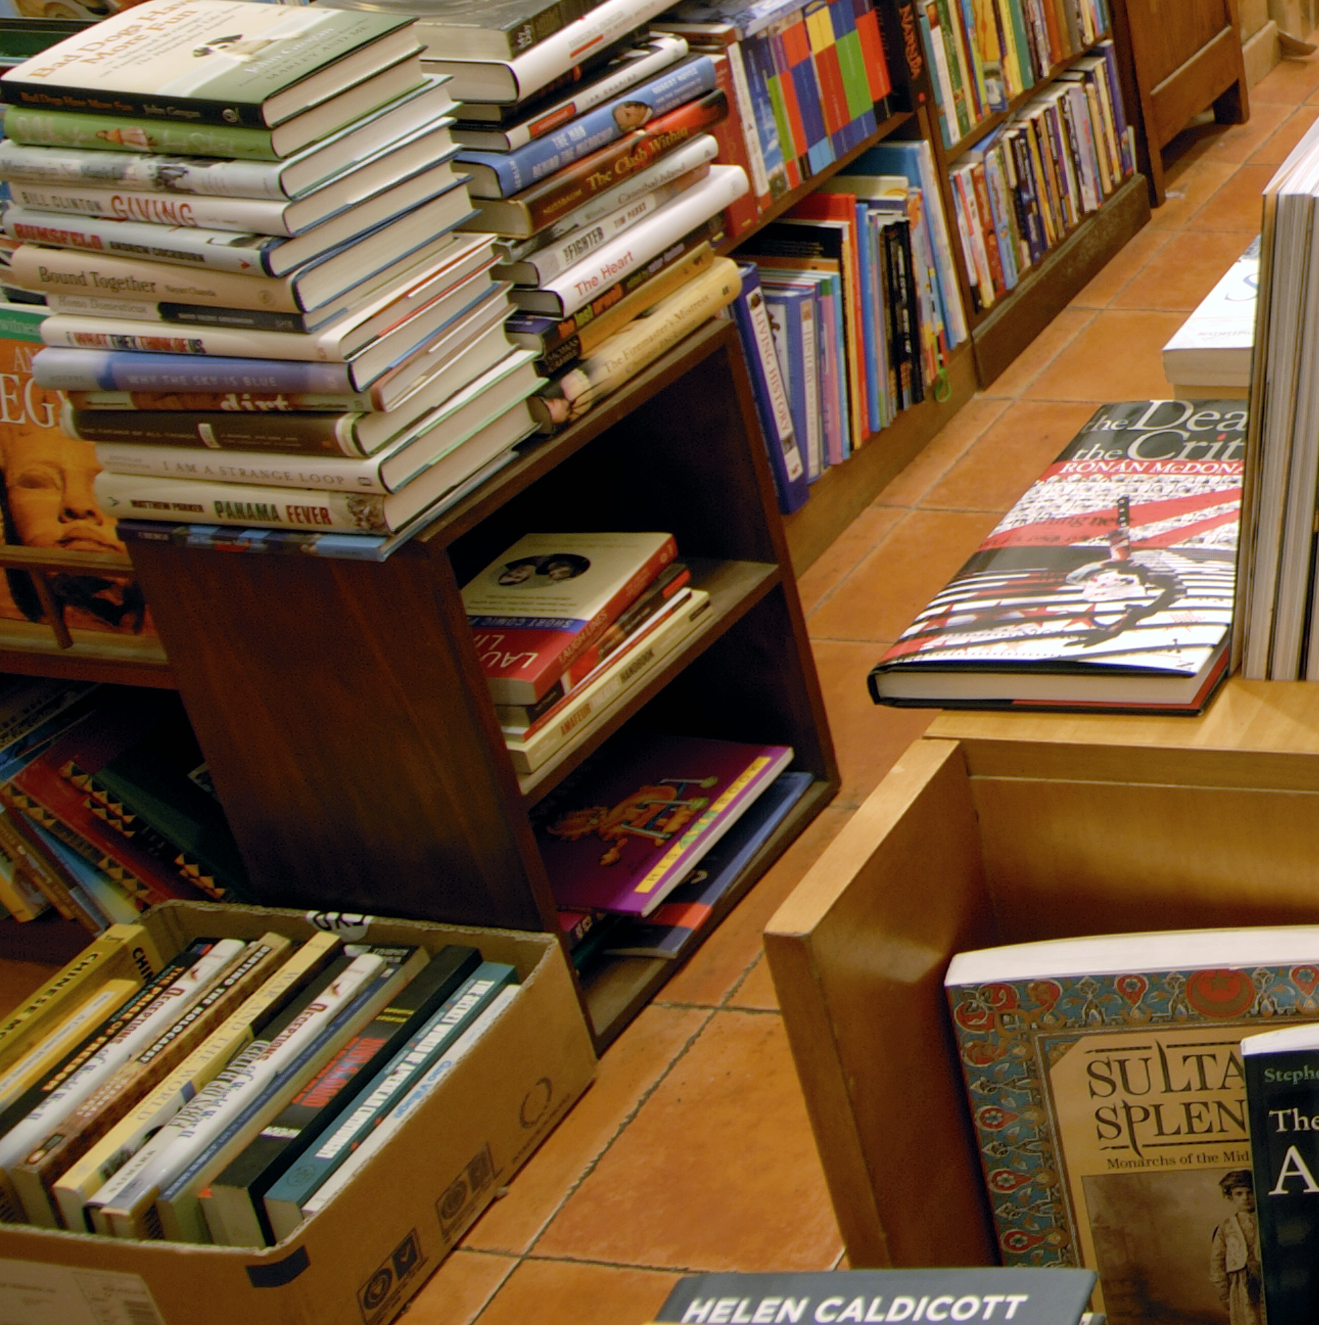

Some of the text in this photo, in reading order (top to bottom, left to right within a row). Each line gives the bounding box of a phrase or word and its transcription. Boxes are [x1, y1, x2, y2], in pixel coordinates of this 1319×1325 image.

[21, 192, 198, 226] BILL CLINTON GIVING
[15, 223, 104, 250] RUMSFELD
[38, 266, 156, 295] Bound Together
[575, 251, 635, 296] The Heart
[220, 394, 289, 411] dirt
[1073, 428, 1245, 463] the Crit
[219, 465, 344, 485] STRANGE LOOP
[1058, 460, 1245, 475] RONÁN McDONA
[214, 500, 332, 526] PANAMA FEVER
[1086, 1039, 1246, 1100] SULTA
[1094, 1099, 1247, 1158] SPLEN
[1107, 1152, 1220, 1170] Monarchs of the
[681, 1294, 1028, 1324] HELEN CALDICOTT
